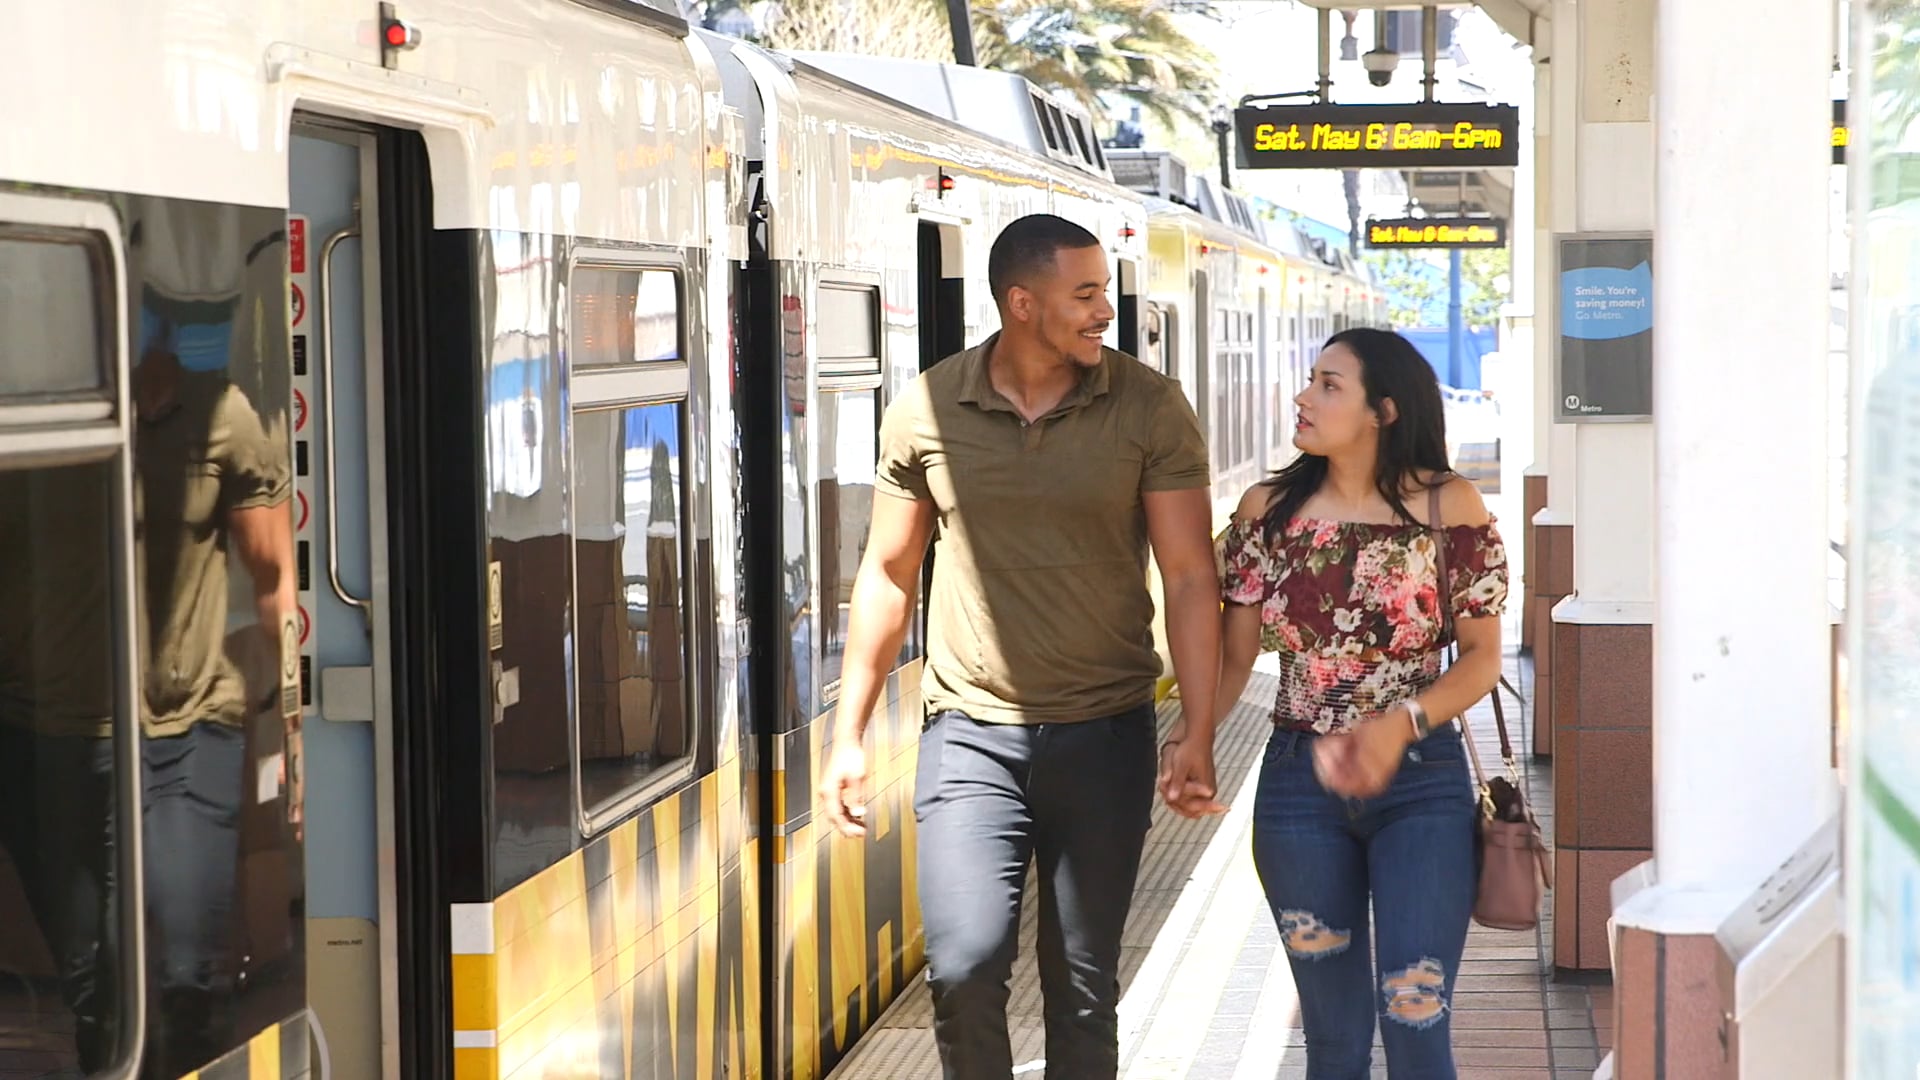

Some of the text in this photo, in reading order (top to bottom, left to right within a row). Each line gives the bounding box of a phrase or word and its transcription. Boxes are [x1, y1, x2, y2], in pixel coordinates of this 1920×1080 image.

[1255, 124, 1306, 150] Sat.
[1312, 123, 1361, 150] May
[1392, 122, 1502, 150] 6am-6pm
[1575, 286, 1638, 296] Smile. You're
[1575, 297, 1645, 310] saving money!
[1575, 311, 1590, 320] Go
